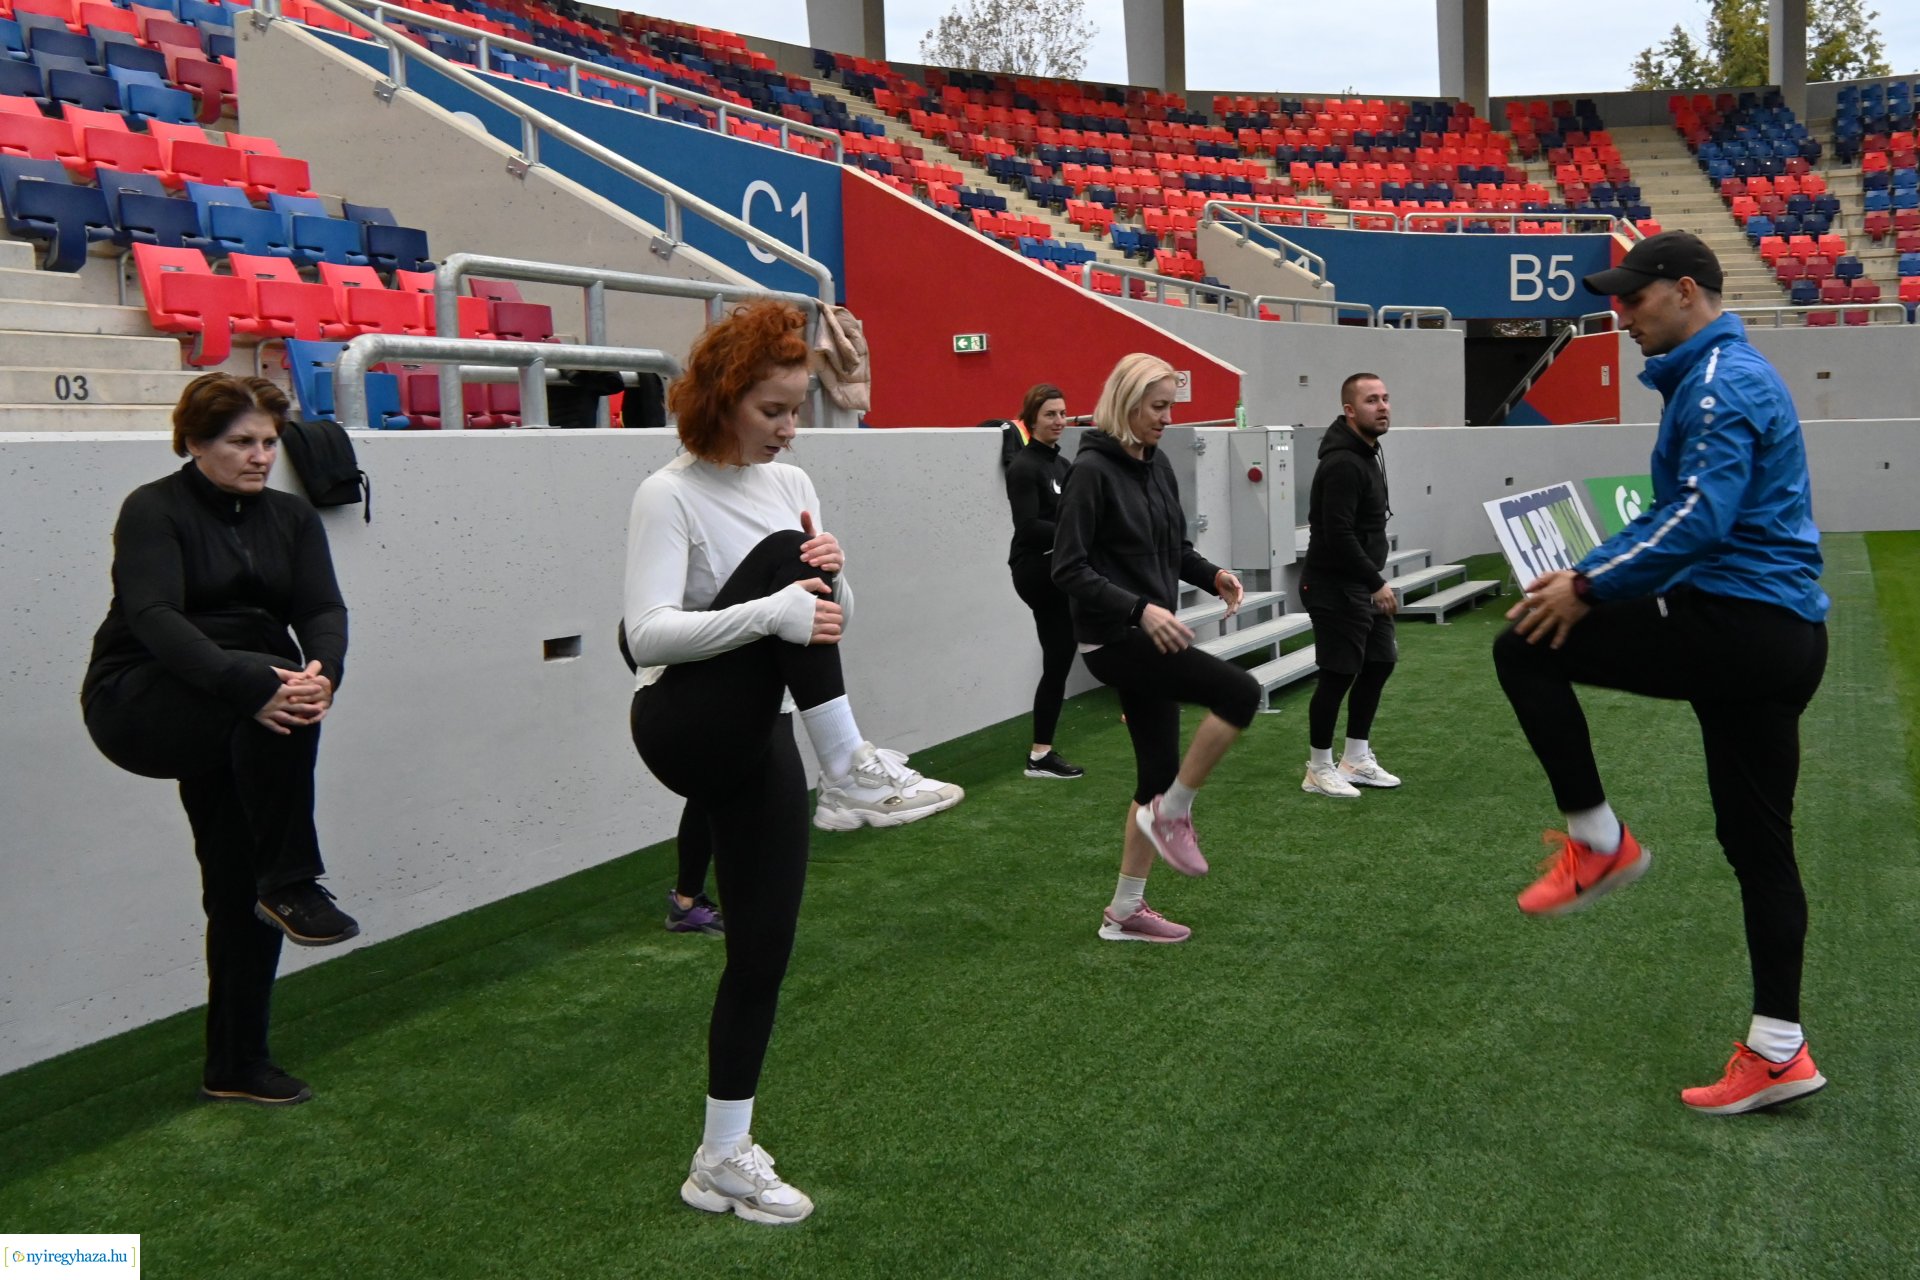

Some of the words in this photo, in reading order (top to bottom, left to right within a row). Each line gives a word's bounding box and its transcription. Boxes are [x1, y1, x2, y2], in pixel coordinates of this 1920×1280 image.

[742, 179, 809, 264] C1
[1510, 254, 1576, 302] B5
[55, 374, 89, 401] 03
